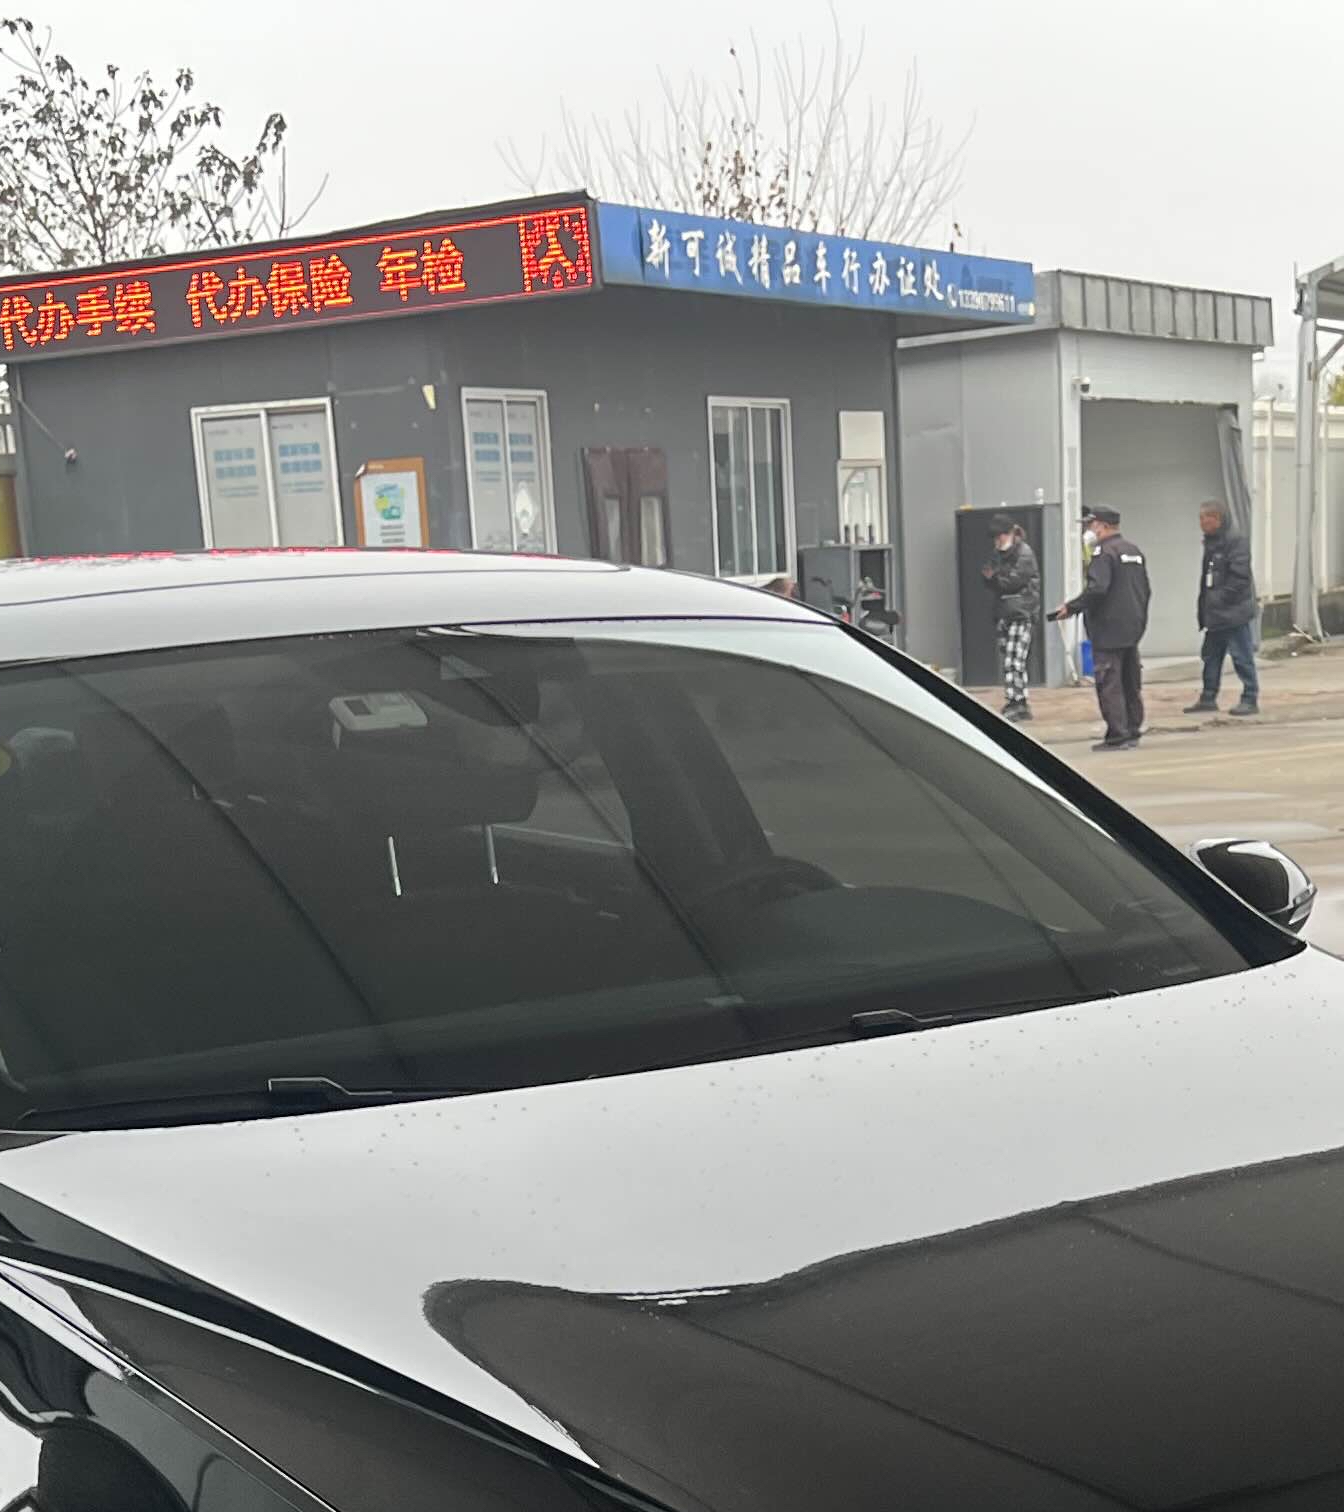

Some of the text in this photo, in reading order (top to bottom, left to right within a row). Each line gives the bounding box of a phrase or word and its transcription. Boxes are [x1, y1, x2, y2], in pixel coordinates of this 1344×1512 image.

[186, 253, 353, 328] 代办保险
[376, 237, 466, 302] 年检
